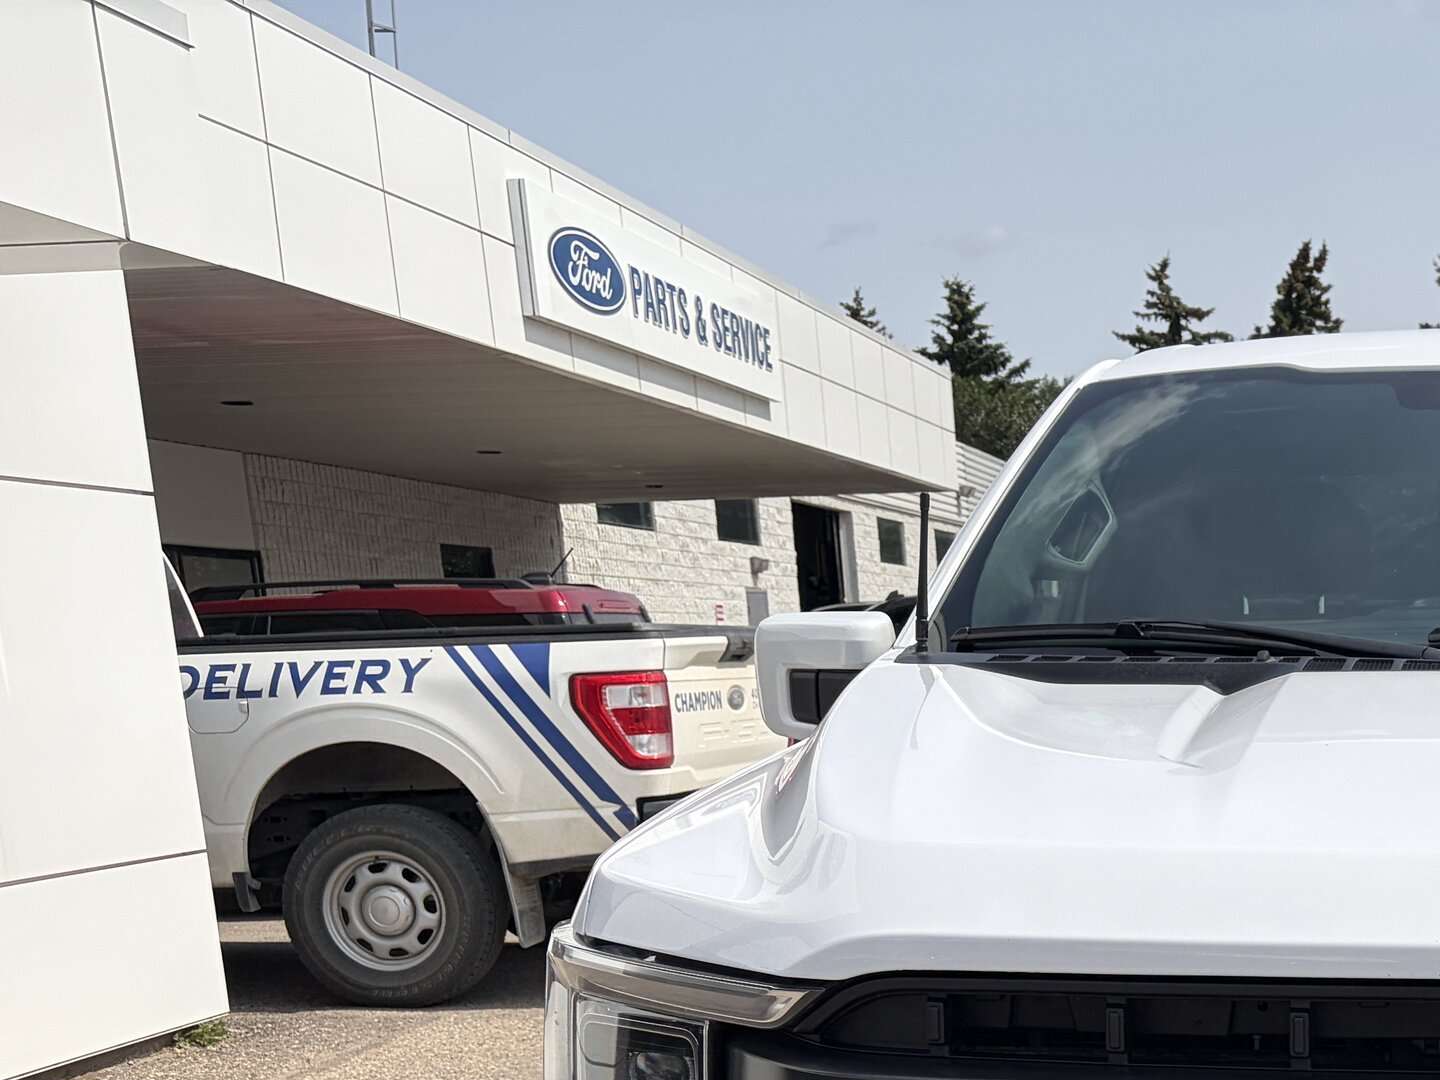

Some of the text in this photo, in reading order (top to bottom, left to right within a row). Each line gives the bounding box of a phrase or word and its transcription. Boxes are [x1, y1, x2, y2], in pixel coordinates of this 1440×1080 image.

[568, 240, 613, 299] Ford
[628, 264, 773, 371] PARTS & SERVICE
[674, 689, 723, 713] CHAMPION
